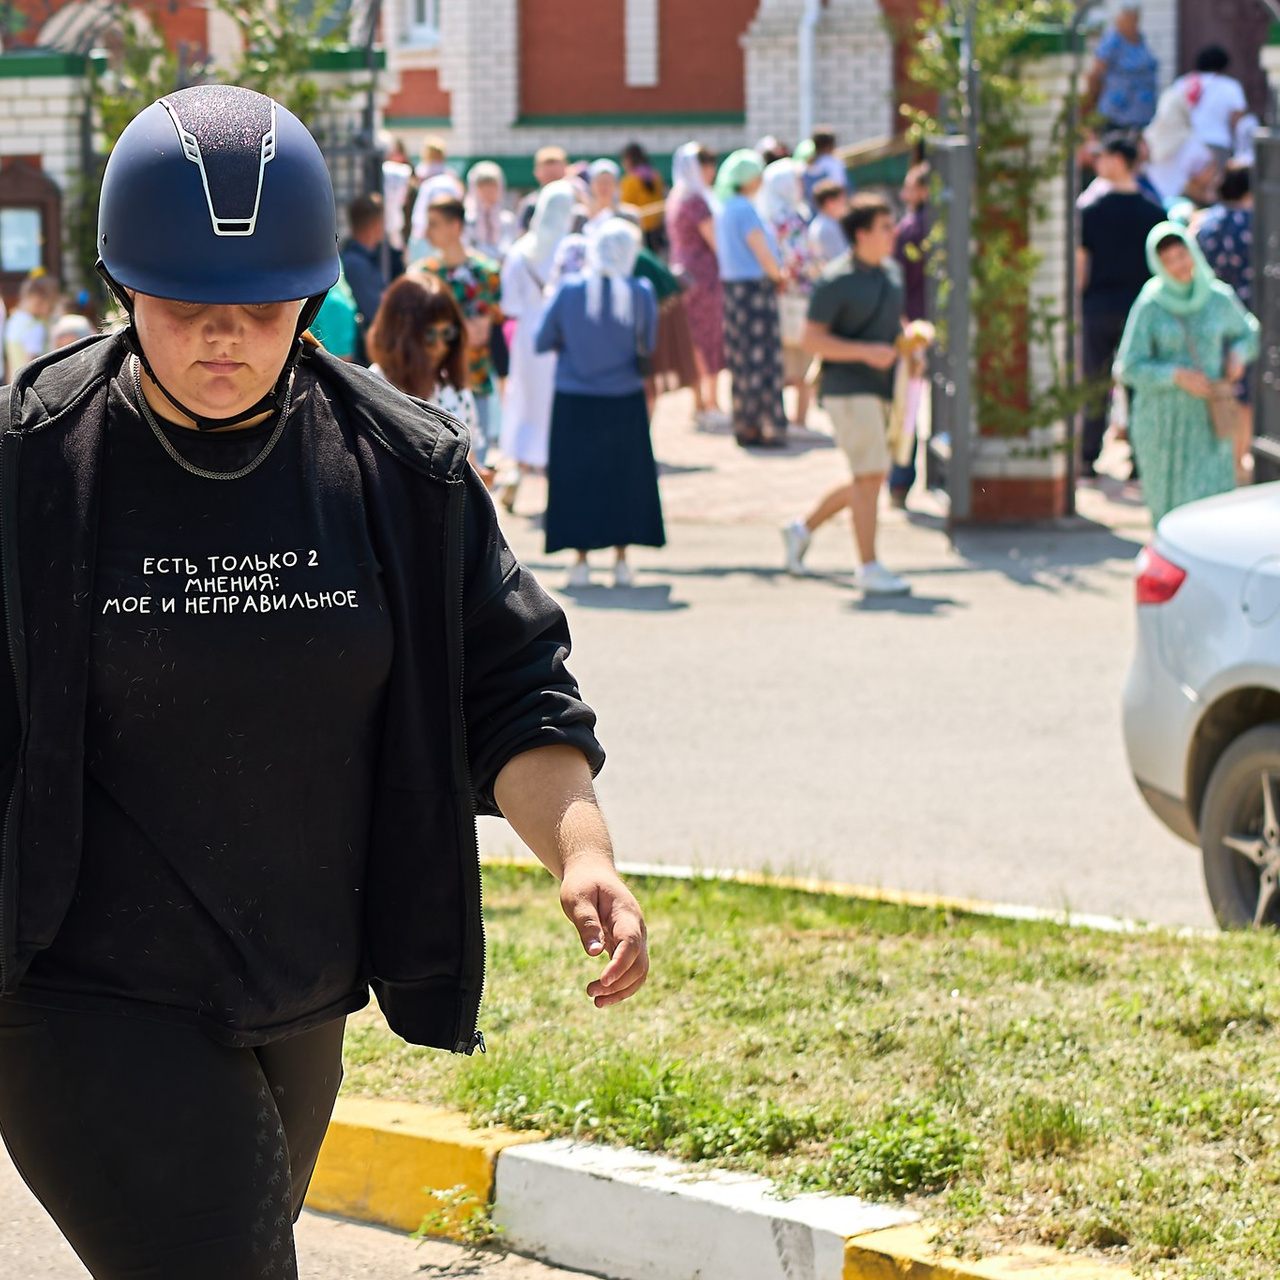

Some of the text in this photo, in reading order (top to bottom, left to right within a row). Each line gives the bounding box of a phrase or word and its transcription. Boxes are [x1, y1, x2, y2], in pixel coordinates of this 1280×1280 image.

[143, 549, 319, 575] ЕСТЬ ТОЛЬКО 2
[184, 573, 280, 593] МНЕНИЯ:
[102, 589, 359, 615] МОЕ И НЕПРАВИЛЬНОЕ
